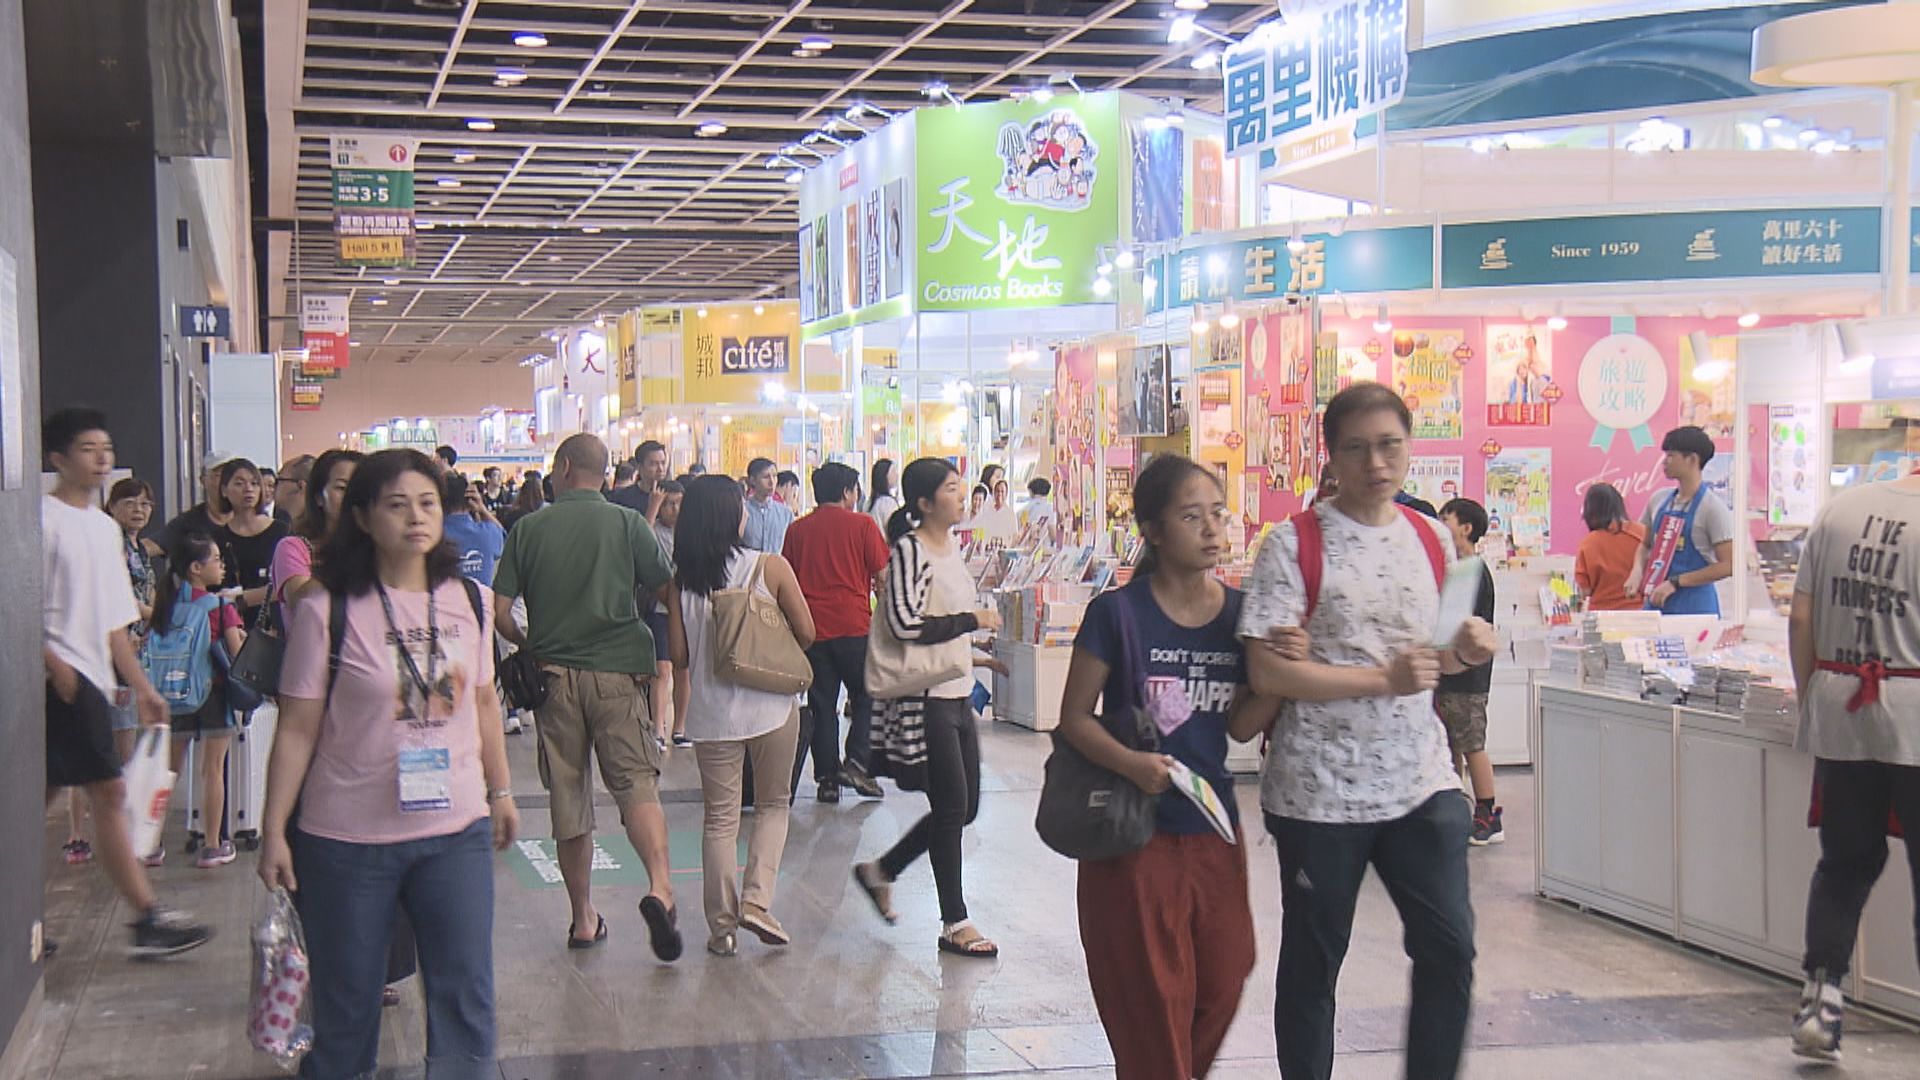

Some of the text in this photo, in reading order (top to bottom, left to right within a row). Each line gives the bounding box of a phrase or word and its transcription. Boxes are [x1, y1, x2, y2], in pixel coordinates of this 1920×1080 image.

[926, 175, 1063, 281] 天地
[1761, 219, 1843, 241] 萬里六十
[1550, 240, 1641, 259] Since 1959
[924, 275, 1064, 303] Cosmos Books
[1848, 543, 1885, 578] GOT
[1149, 647, 1190, 664] DON'T
[1178, 679, 1237, 714] HAPP
